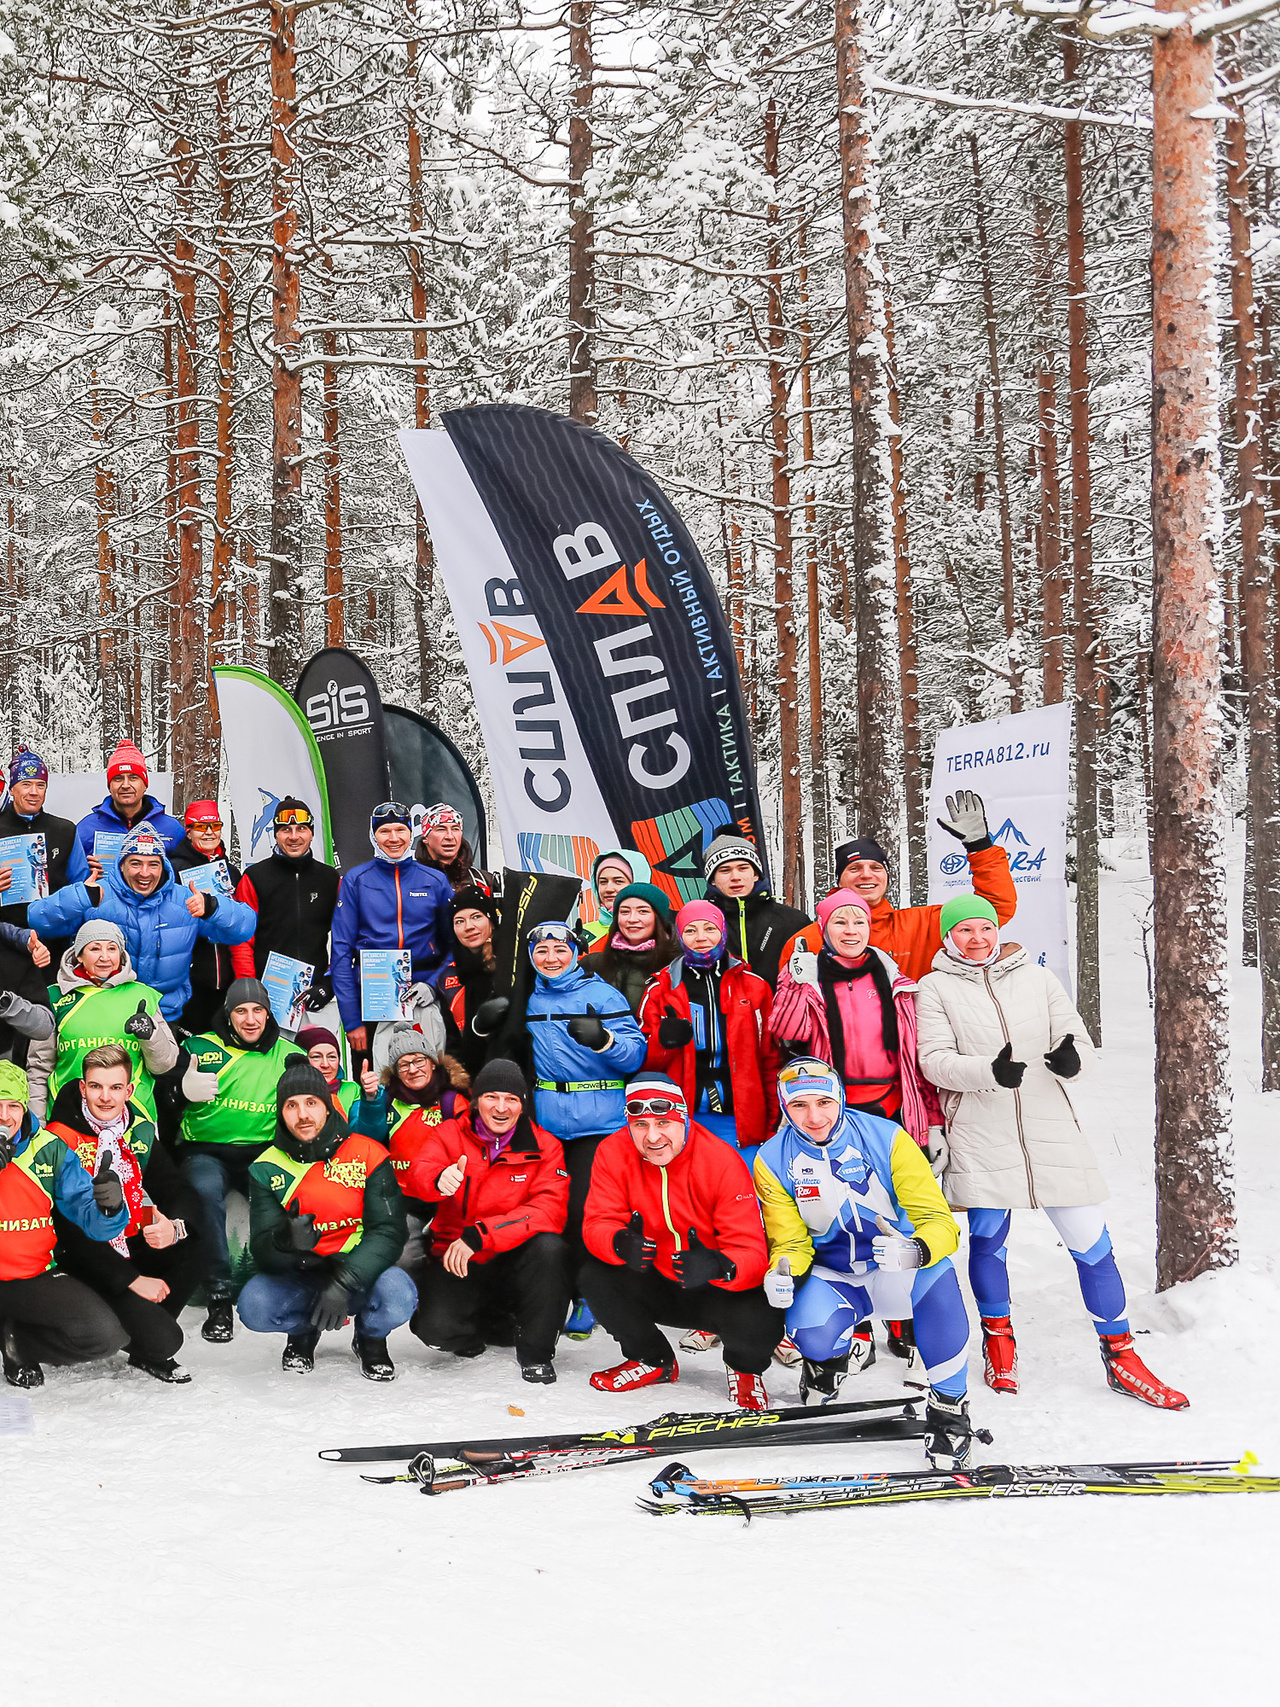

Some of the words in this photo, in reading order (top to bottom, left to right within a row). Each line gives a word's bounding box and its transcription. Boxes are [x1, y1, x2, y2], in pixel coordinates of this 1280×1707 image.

[636, 499, 682, 565] ОТДЫХ
[670, 569, 723, 680] АКТИВНЫЙ
[552, 521, 691, 789] СПЛАВ
[317, 733, 336, 742] ENCE
[348, 727, 372, 737] SPORT
[716, 703, 743, 796] ТАКТИКА
[946, 741, 1051, 773] TERRA812.ru
[59, 1037, 140, 1053] ОРГАНИЗАТО
[206, 1097, 277, 1113] ГАНИЗАТО
[613, 1362, 657, 1388] alpi
[647, 1414, 780, 1442] FISCHER
[989, 1482, 1087, 1499] FISCHER
